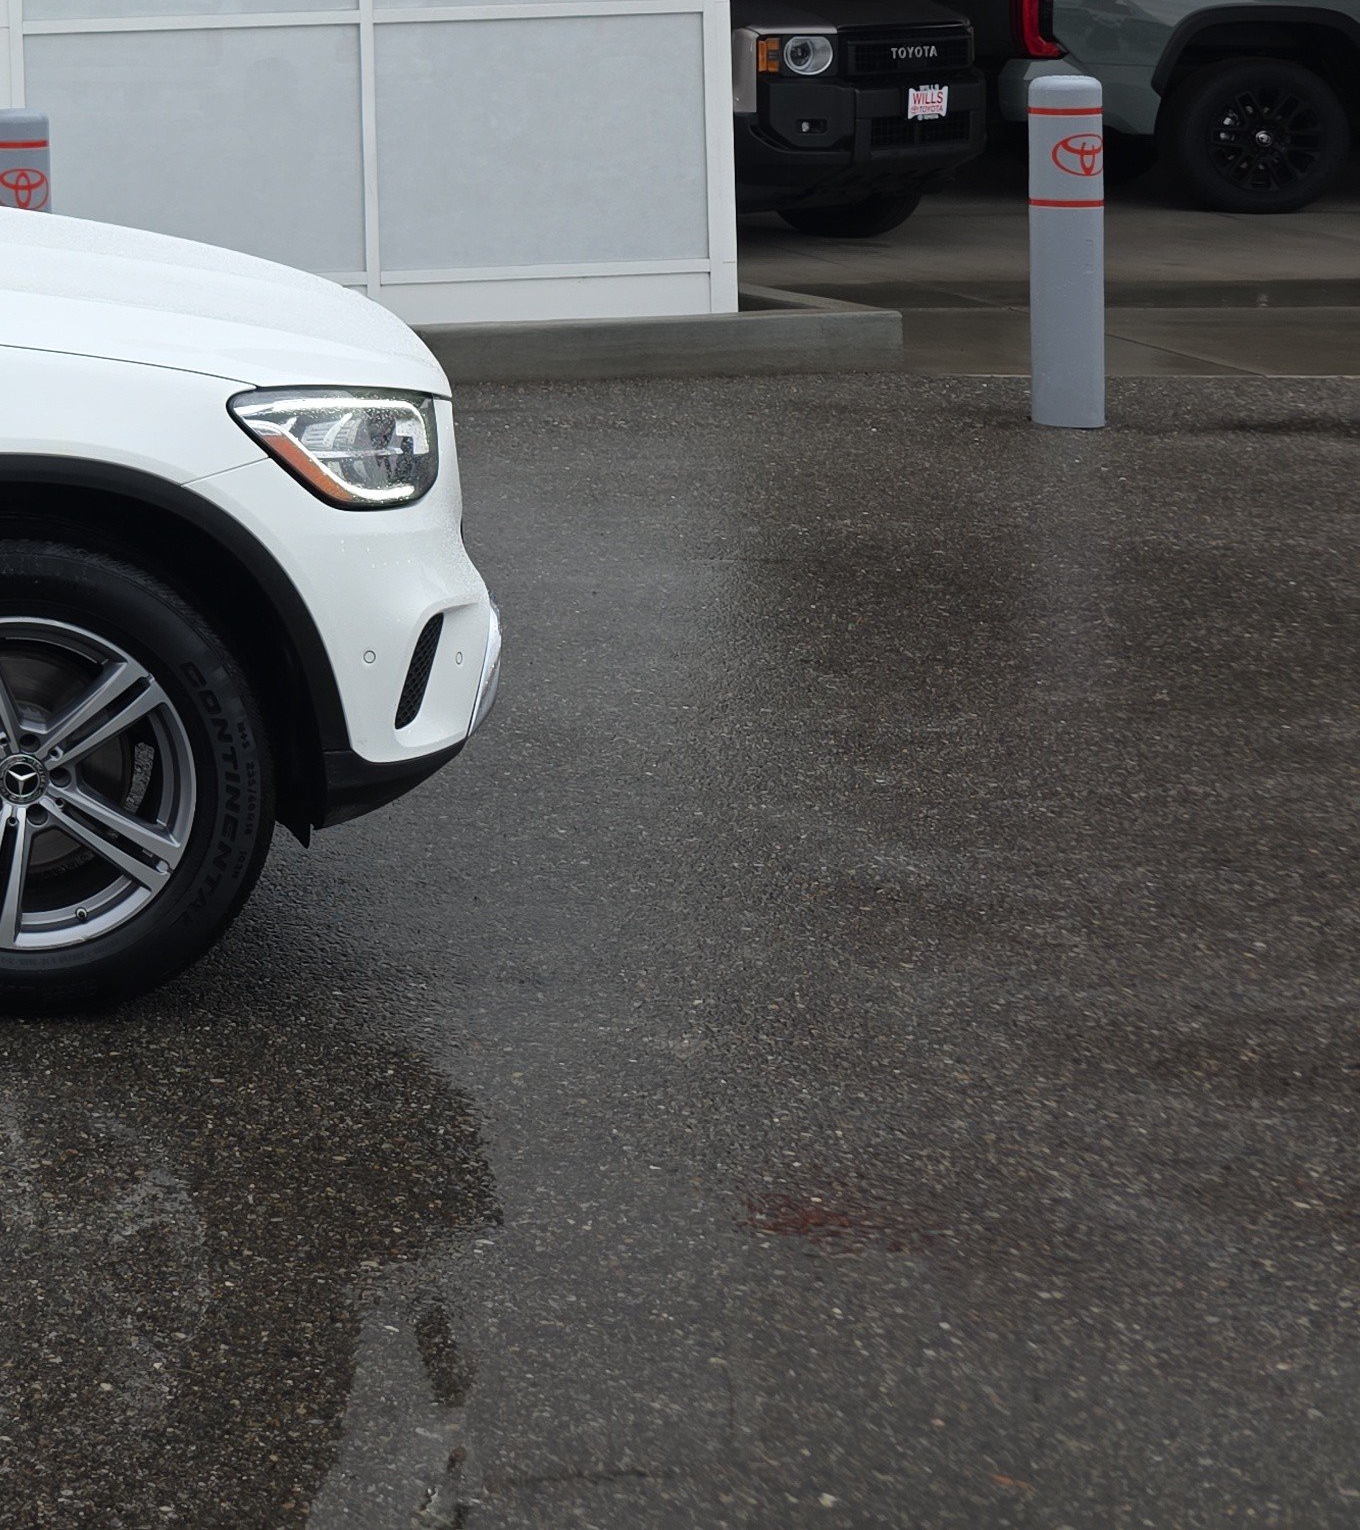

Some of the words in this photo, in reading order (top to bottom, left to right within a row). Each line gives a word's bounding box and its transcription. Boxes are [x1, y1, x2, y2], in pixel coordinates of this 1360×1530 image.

[890, 45, 938, 59] TOYOTA
[912, 91, 944, 105] WILLS
[919, 105, 944, 113] TOYOTA
[172, 662, 243, 932] CONTINENTAL
